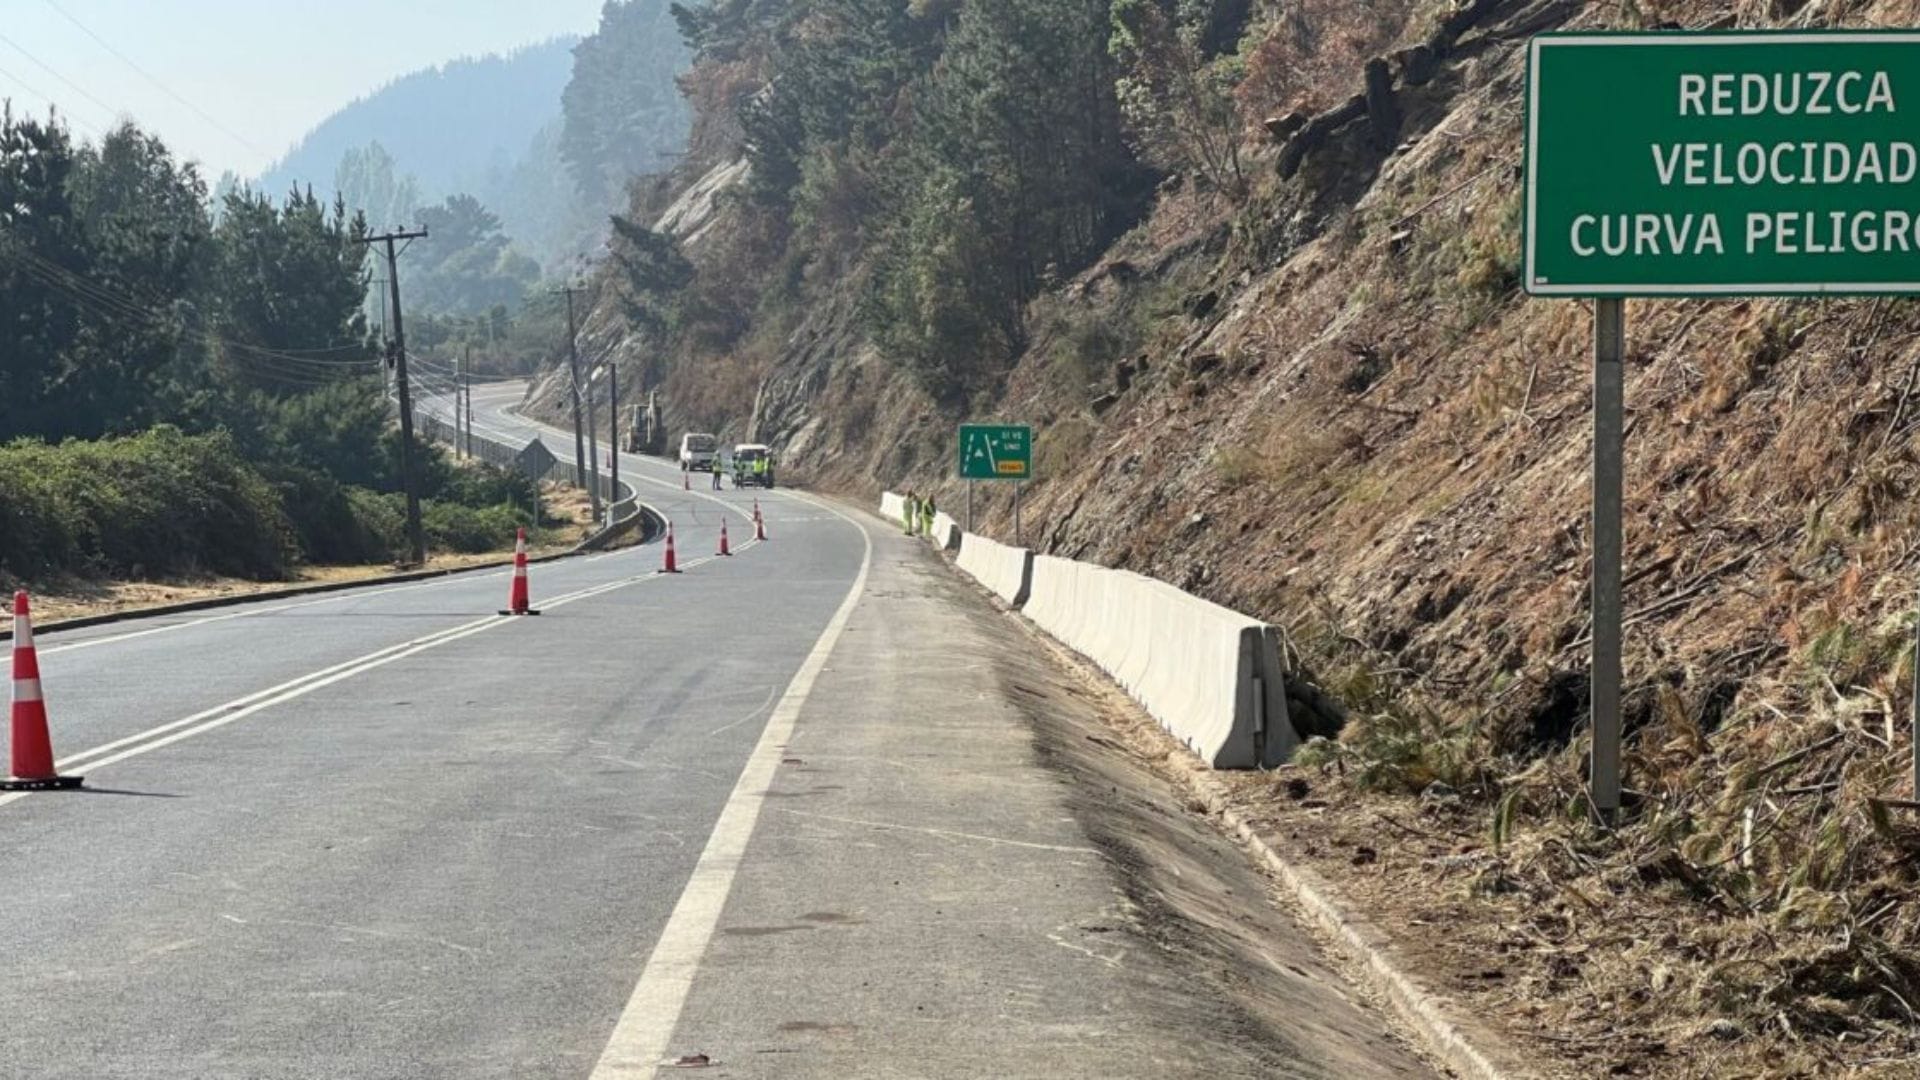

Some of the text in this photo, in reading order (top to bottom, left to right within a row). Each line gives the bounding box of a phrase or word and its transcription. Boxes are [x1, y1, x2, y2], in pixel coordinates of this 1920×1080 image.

[1680, 71, 1895, 116] REDUZCA
[1652, 142, 1917, 186] VELOCIDAD
[1570, 210, 1920, 257] CURVA PELIGR
